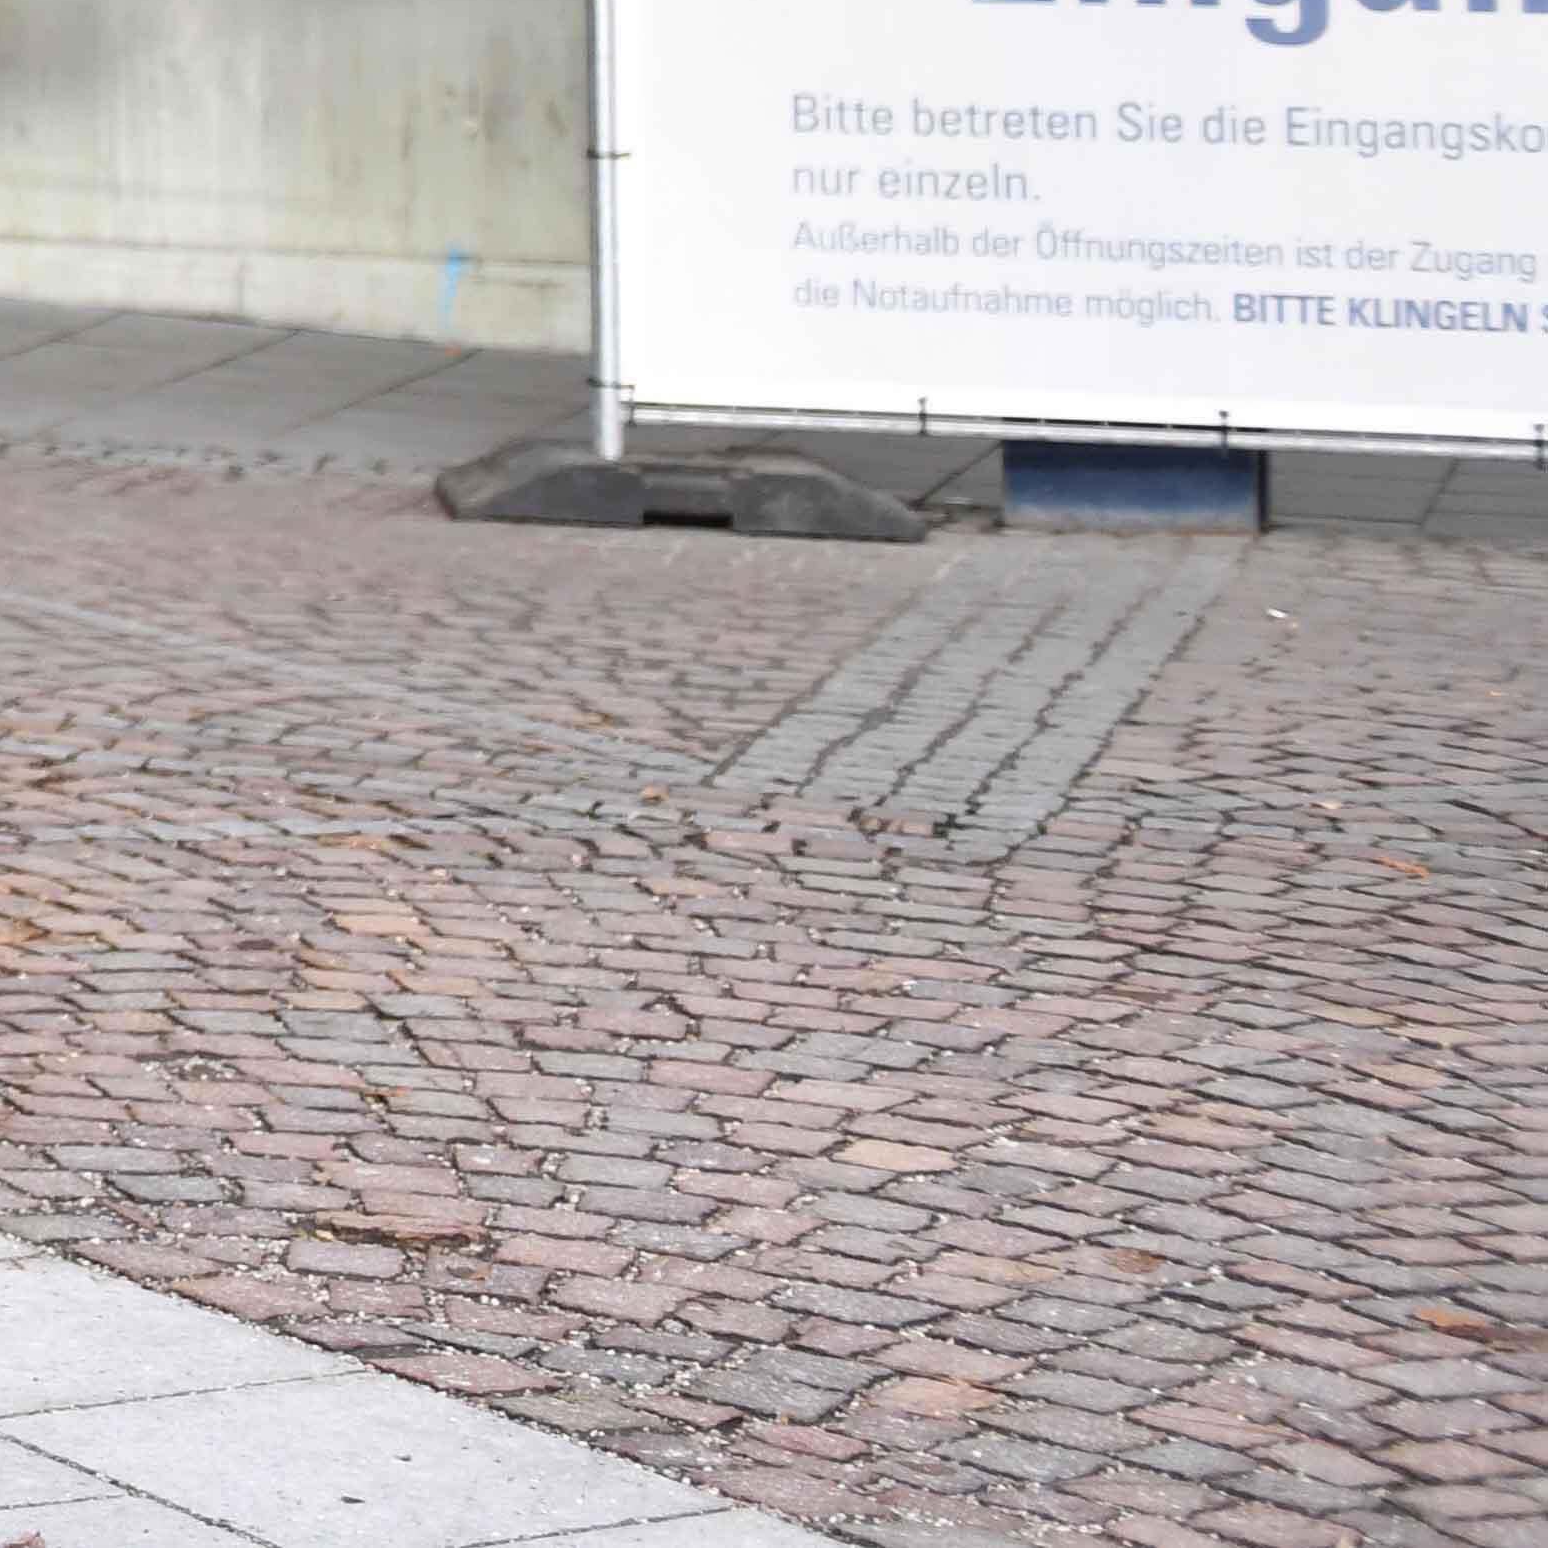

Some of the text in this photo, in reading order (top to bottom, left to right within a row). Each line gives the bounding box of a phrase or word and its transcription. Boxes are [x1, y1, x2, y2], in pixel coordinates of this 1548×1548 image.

[793, 92, 1548, 160] Bitte betreten Sie die Eingangsko
[793, 157, 1041, 201] nur einzeln.
[793, 220, 1537, 283] Außerhalb der Öffnungszeiten ist der Zugang
[794, 278, 840, 307] die
[853, 279, 1073, 317] Notaufnahme
[1085, 291, 1221, 326] möglich.
[1233, 293, 1336, 325] BITTE
[1348, 296, 1529, 333] KLINGELN
